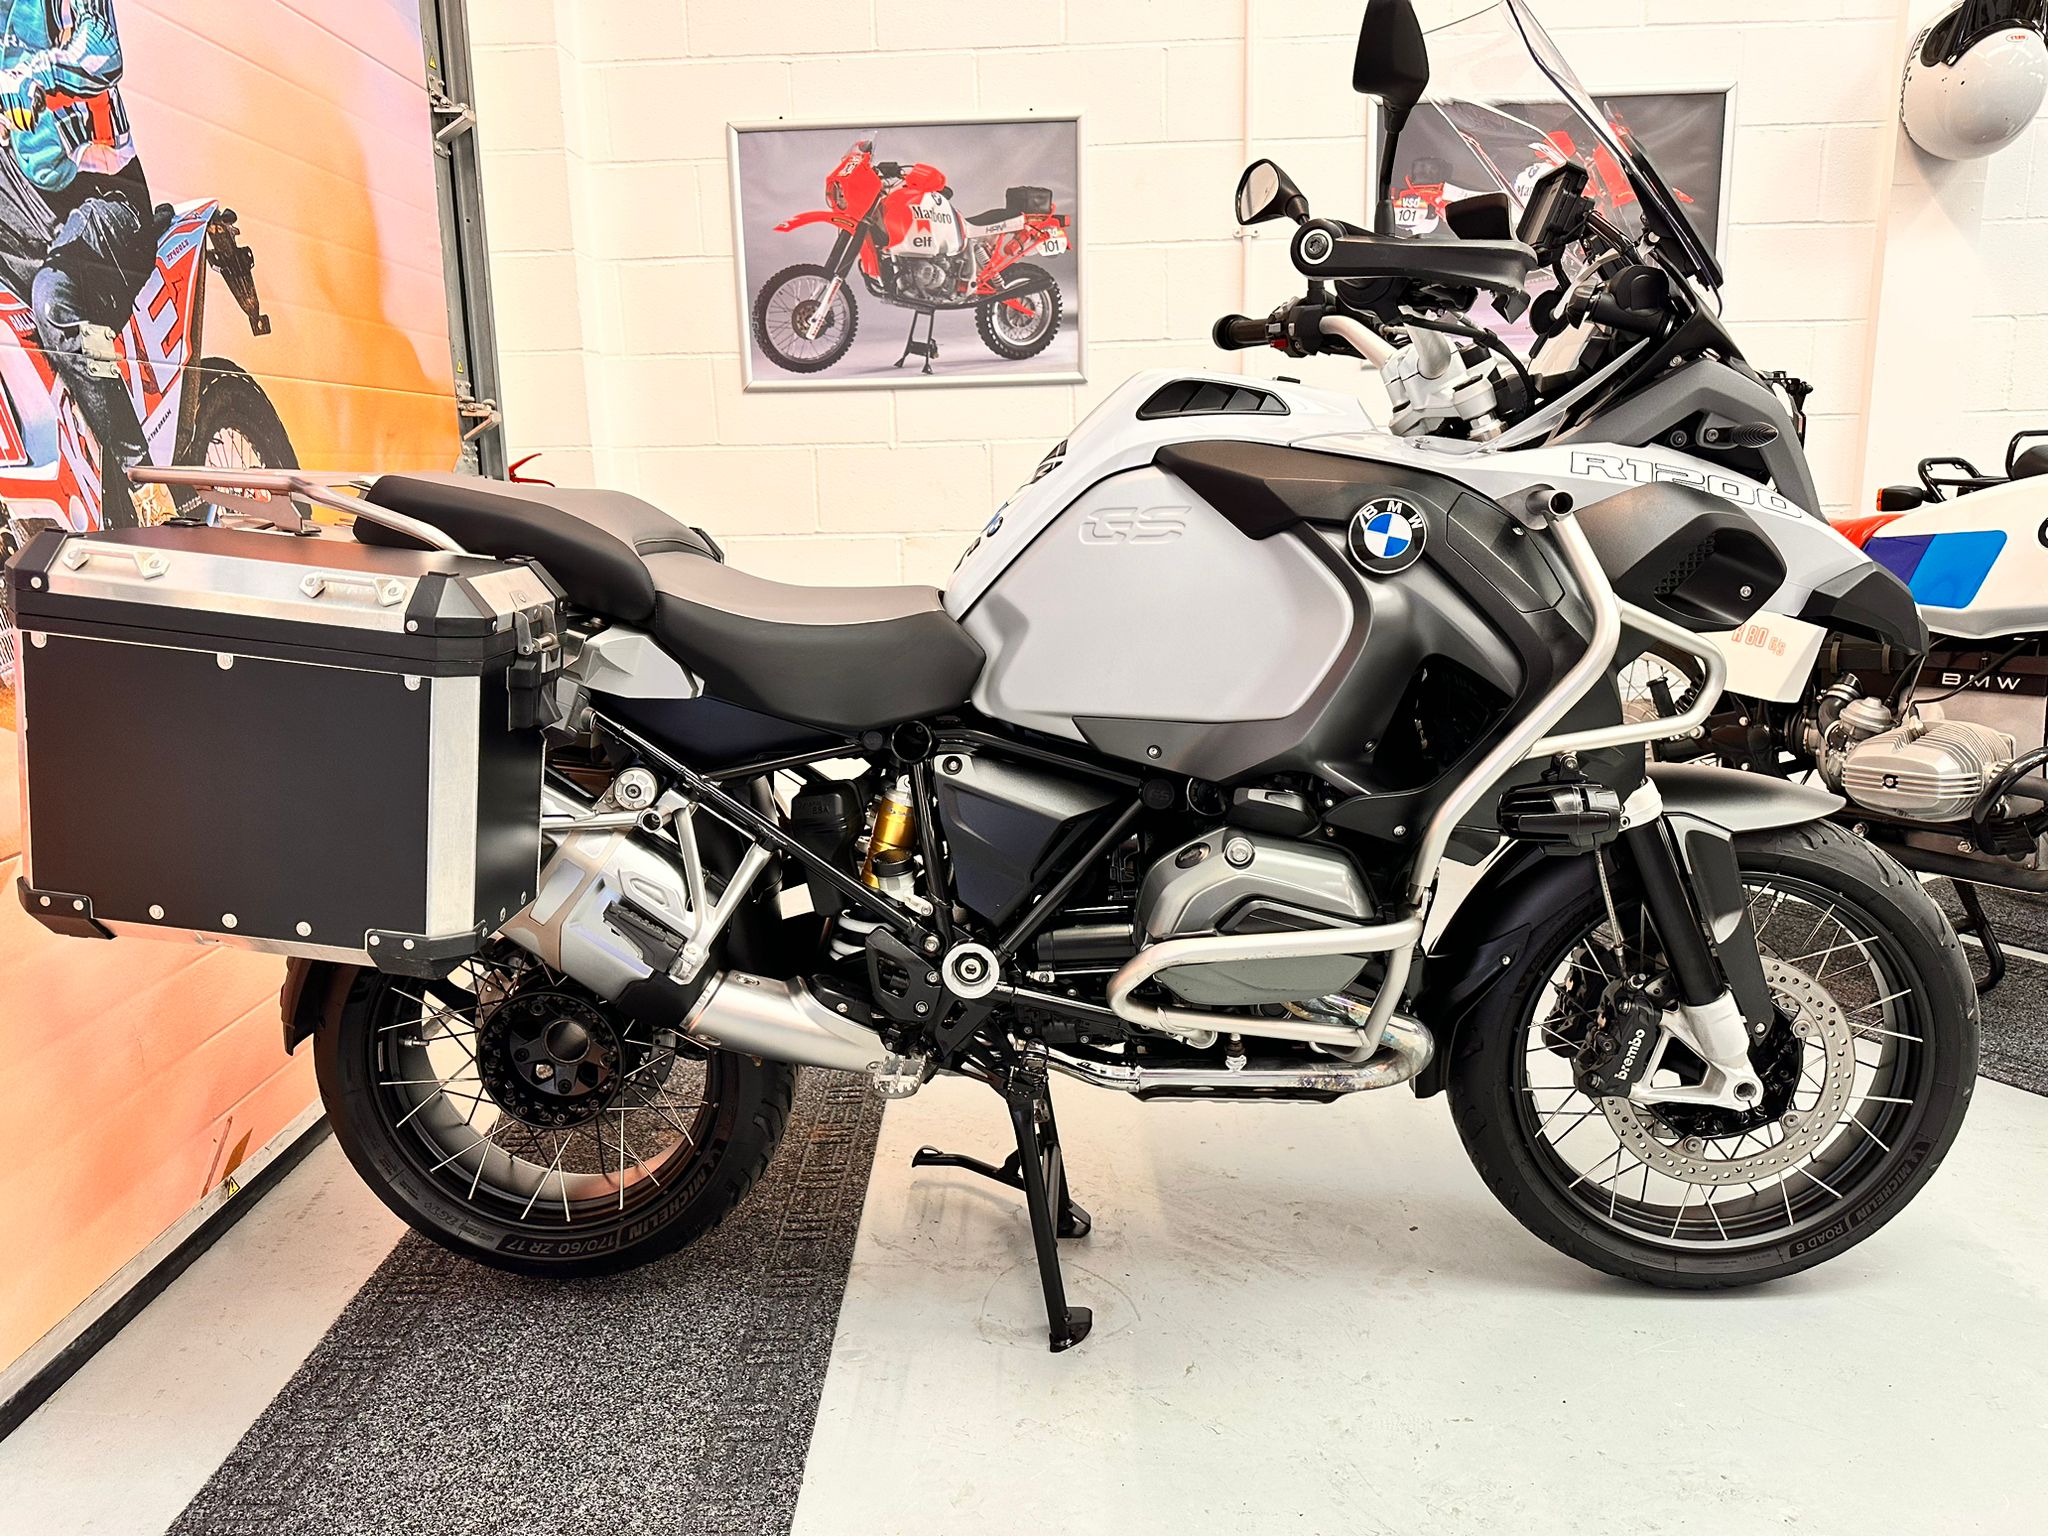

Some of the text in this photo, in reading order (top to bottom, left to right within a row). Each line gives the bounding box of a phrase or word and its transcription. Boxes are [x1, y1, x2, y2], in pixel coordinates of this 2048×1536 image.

[911, 205, 952, 224] Marlboro
[1399, 209, 1417, 222] 101
[912, 236, 932, 248] elf
[1042, 240, 1060, 252] 101
[1570, 451, 1803, 519] R1200
[1078, 505, 1193, 545] GS
[1360, 500, 1424, 529] BMW
[1731, 624, 1747, 643] R
[1745, 625, 1770, 648] 80
[1941, 672, 2021, 691] BMW
[1613, 1028, 1646, 1081] brembo
[506, 1172, 708, 1255] MICHELIN 170/60 ZR 17
[1795, 1164, 1913, 1254] MICHELIN ROAD 6
